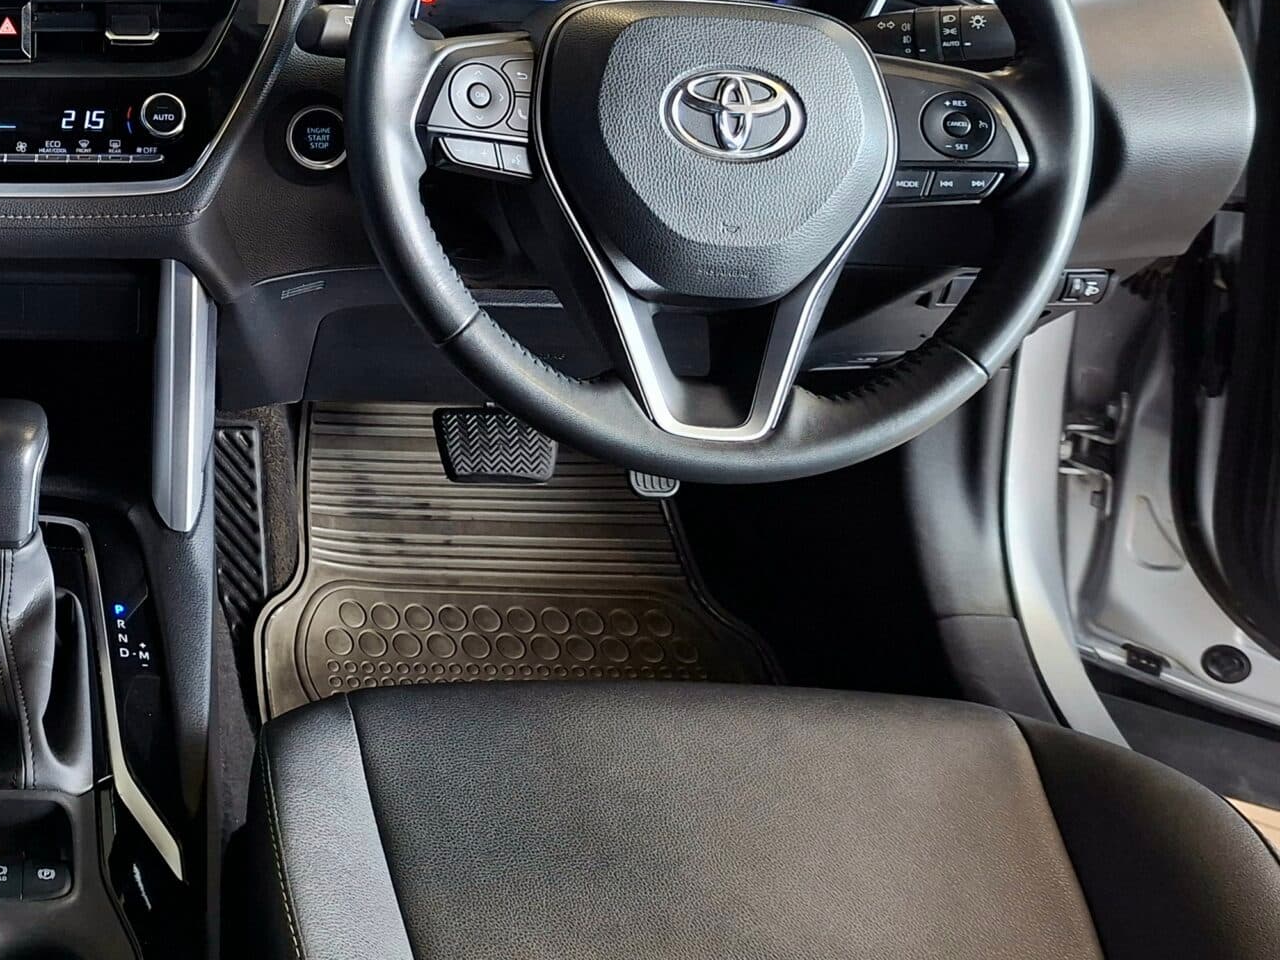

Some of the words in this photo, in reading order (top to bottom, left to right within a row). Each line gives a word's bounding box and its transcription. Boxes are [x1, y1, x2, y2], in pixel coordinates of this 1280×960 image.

[152, 113, 175, 121] AUTO
[45, 140, 61, 148] ECO
[896, 180, 919, 188] MODE
[114, 604, 124, 614] P
[117, 619, 126, 629] R
[118, 633, 128, 643] N
[120, 647, 130, 658] D
[139, 651, 150, 661] M
